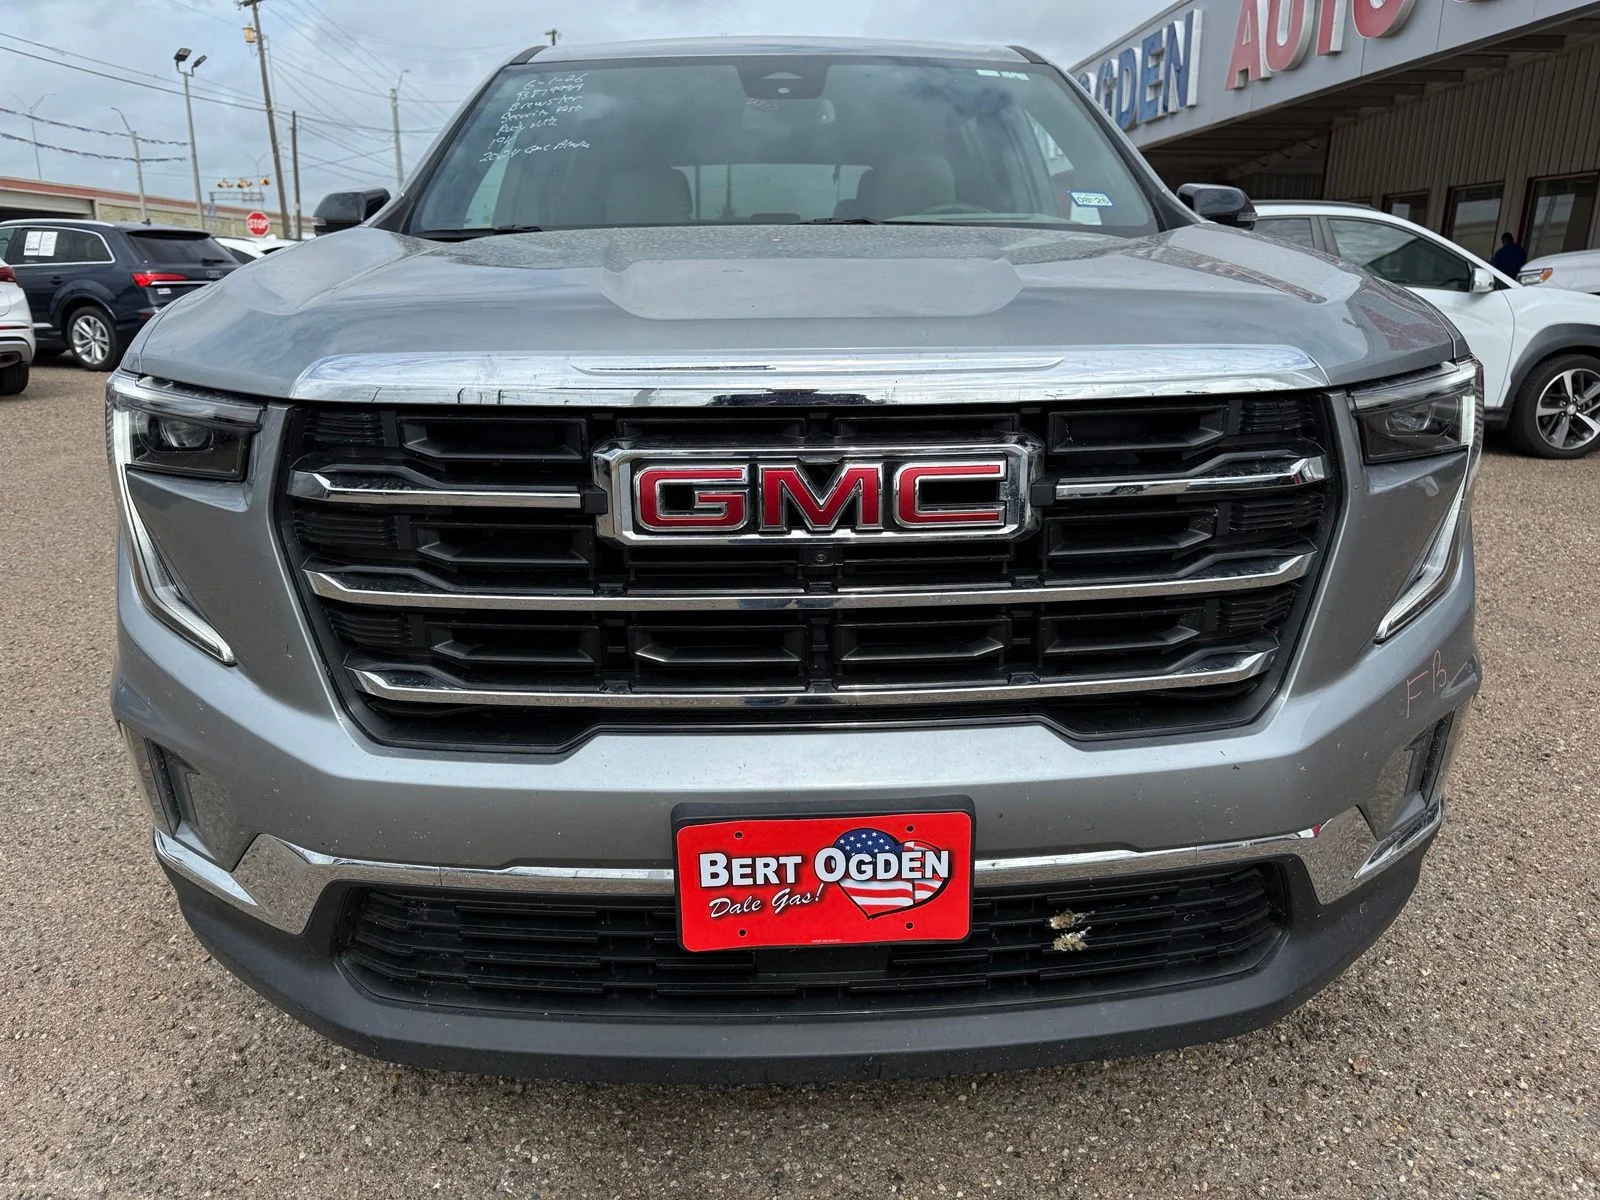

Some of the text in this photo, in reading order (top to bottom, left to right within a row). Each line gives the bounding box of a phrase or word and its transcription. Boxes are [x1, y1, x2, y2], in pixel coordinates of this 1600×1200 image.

[1079, 8, 1203, 133] GDEN
[248, 219, 269, 229] STOP
[633, 460, 1007, 533] GMC
[698, 846, 949, 888] BERT OGDEN
[708, 882, 825, 919] Dale Gas!
